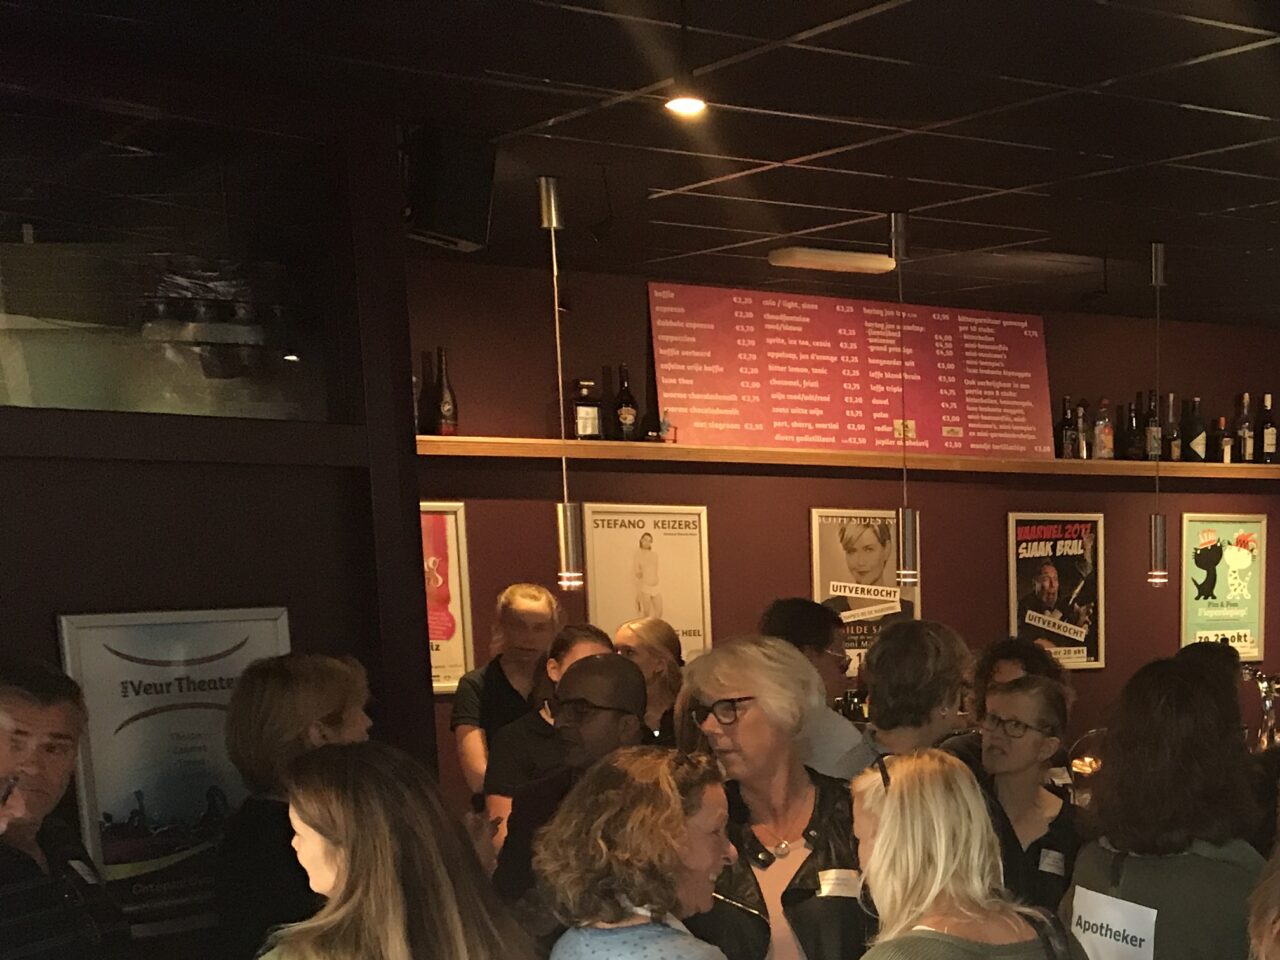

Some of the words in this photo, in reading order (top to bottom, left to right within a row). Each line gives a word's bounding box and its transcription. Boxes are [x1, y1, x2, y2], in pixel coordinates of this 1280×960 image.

[593, 519, 645, 529] STEFANO
[653, 520, 698, 530] KEIZERS
[832, 584, 898, 598] UITVERKOCHT
[1028, 613, 1084, 638] UITVERKOCHT
[681, 629, 702, 637] HEEL
[1230, 632, 1248, 643] okt
[129, 680, 173, 696] Veur
[1075, 914, 1146, 948] Apotheker
